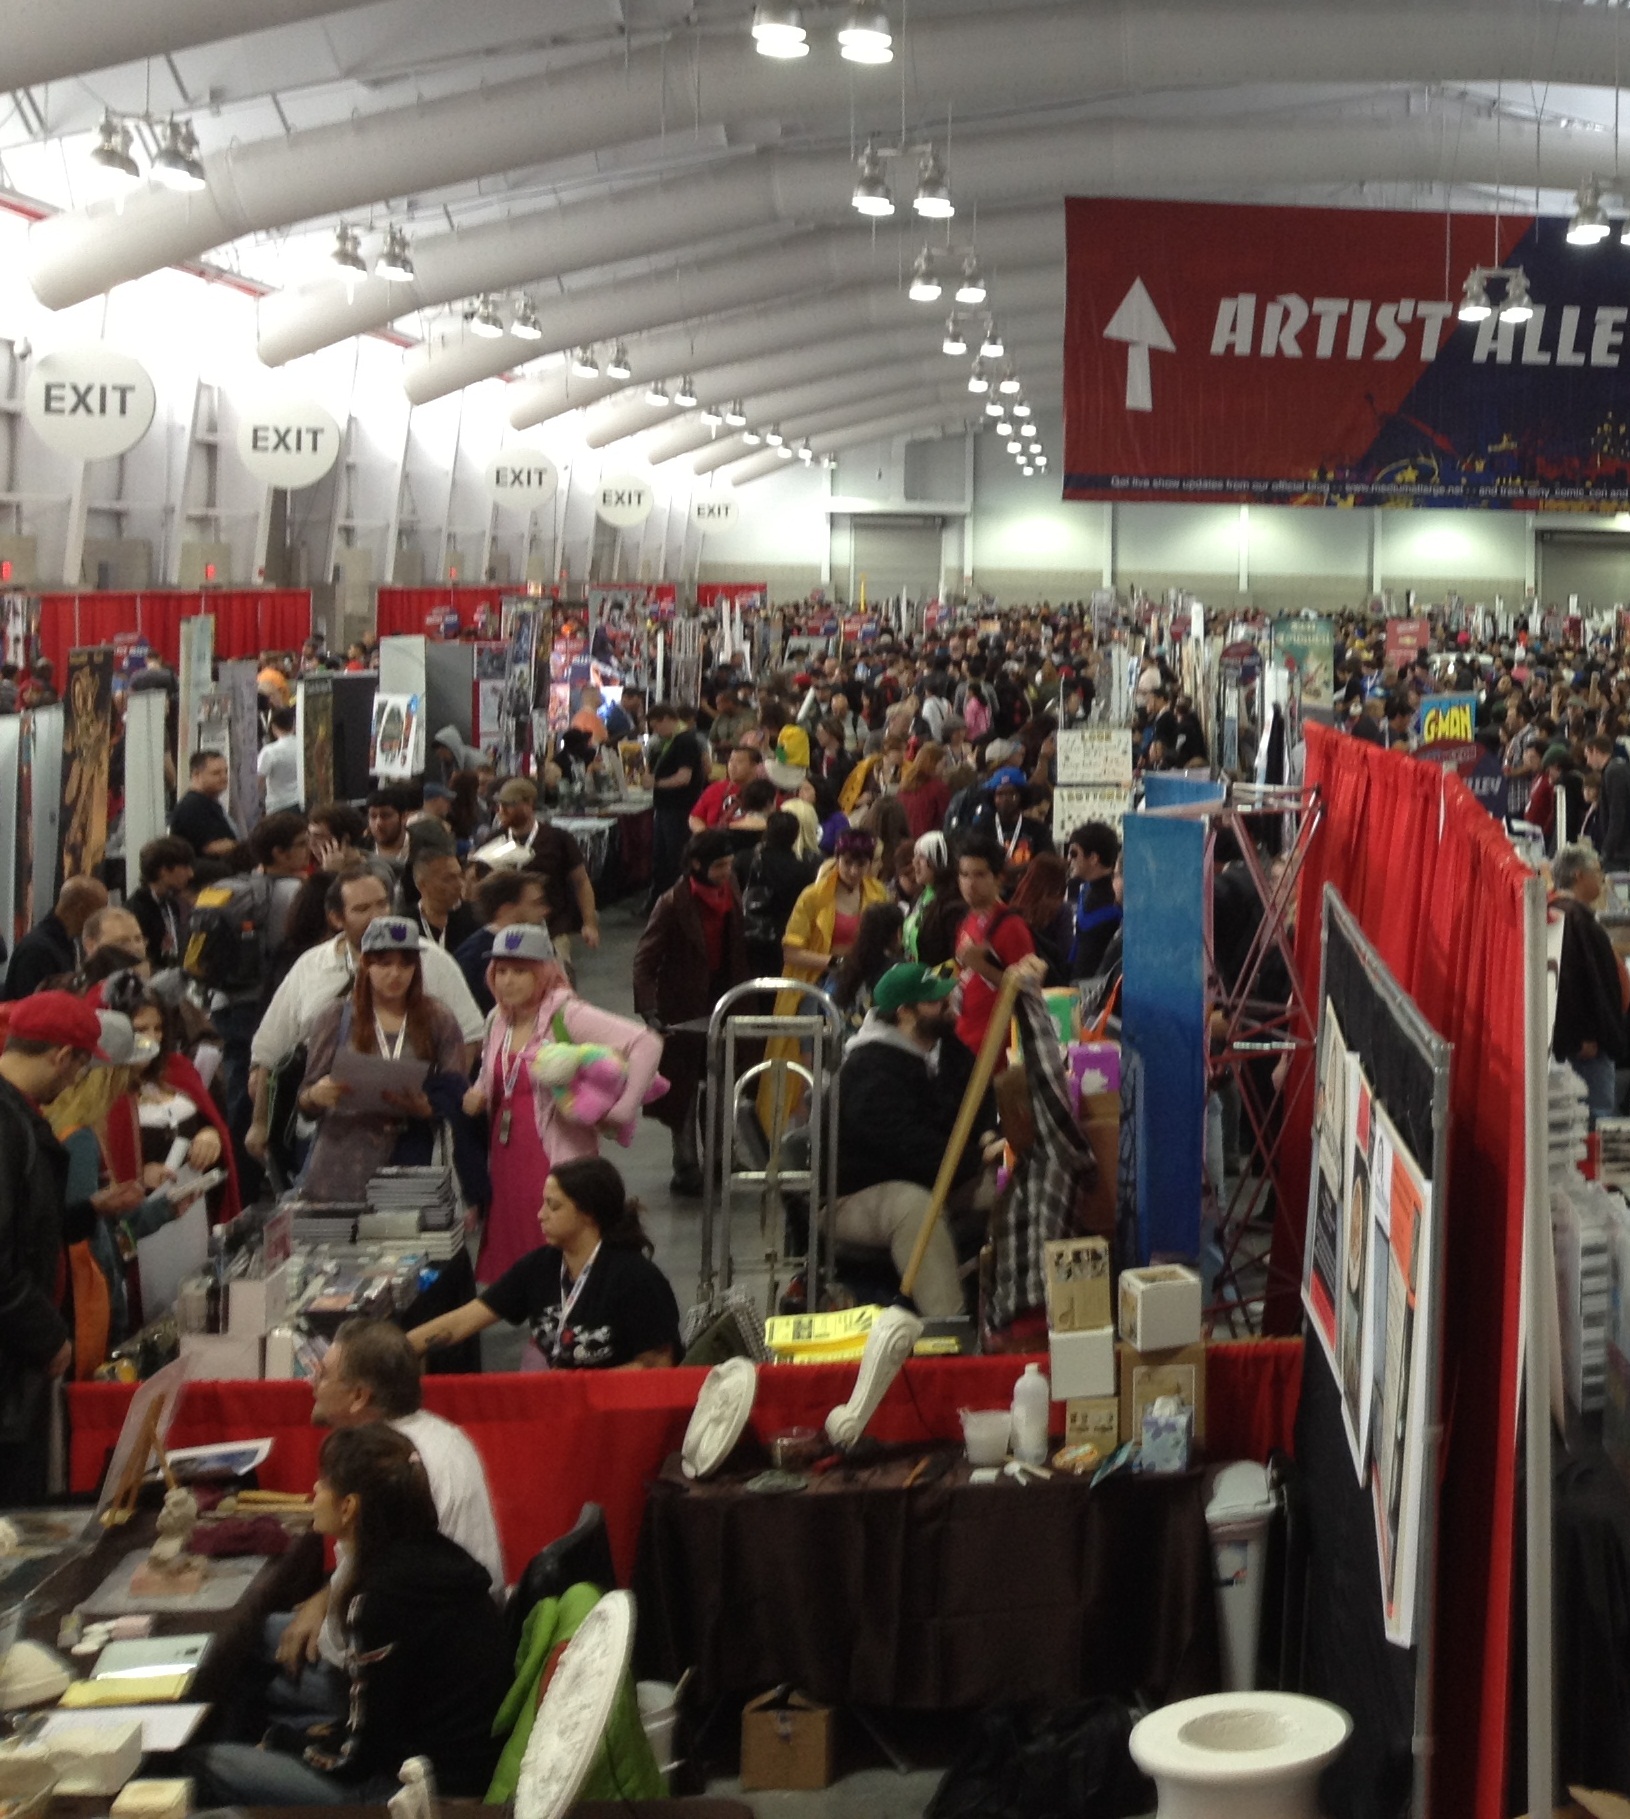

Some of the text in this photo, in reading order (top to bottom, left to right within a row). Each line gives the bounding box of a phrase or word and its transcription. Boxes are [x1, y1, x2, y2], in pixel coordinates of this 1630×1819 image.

[1210, 292, 1453, 362] ARTIST
[44, 383, 135, 417] EXIT
[251, 427, 324, 453] EXIT
[495, 469, 547, 487] EXIT
[1111, 475, 1129, 487] Get
[1132, 476, 1150, 488] live
[1153, 477, 1180, 490] show
[1183, 478, 1223, 491] updates
[1226, 479, 1250, 491] from
[1252, 481, 1268, 491] our
[1271, 480, 1304, 492] official
[1479, 485, 1497, 497] and
[1610, 488, 1628, 498] and
[602, 490, 644, 507] EXIT
[697, 505, 730, 518] EXIT
